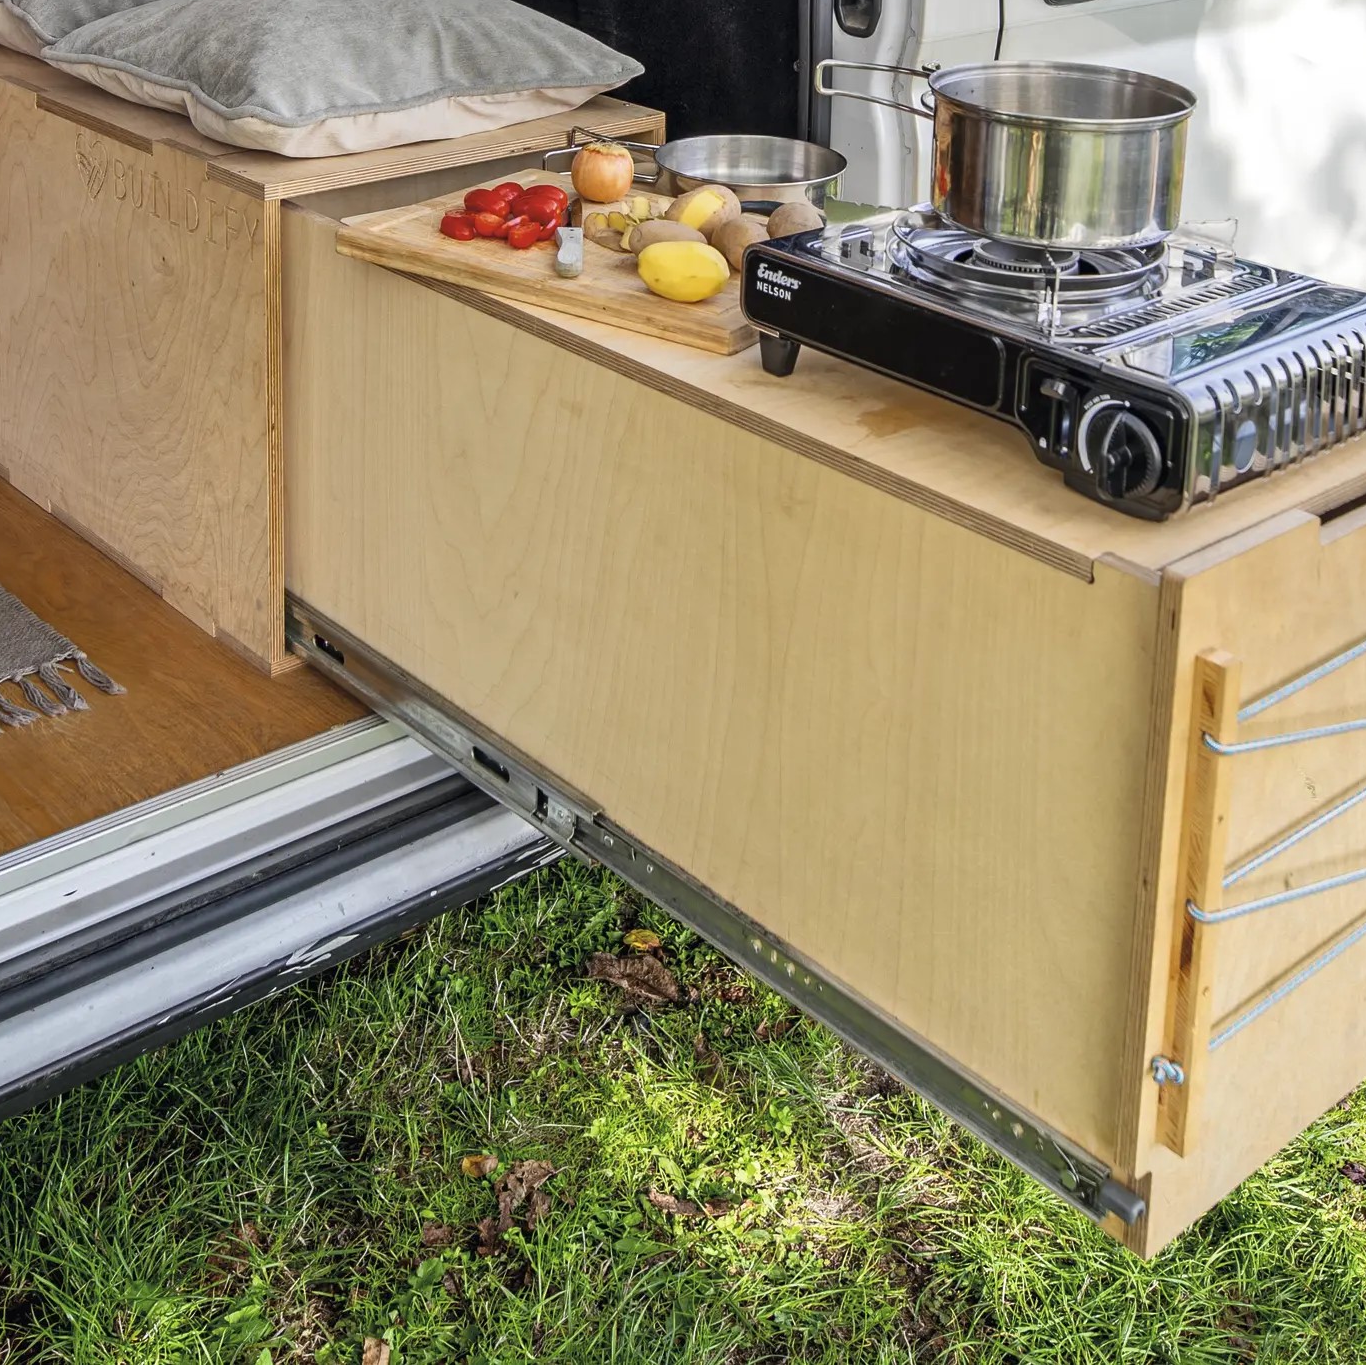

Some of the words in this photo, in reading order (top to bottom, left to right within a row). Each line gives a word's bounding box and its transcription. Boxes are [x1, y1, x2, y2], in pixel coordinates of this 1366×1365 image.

[113, 158, 260, 262] BUILDIFY
[757, 263, 800, 290] Enders
[756, 280, 791, 301] NELSON
